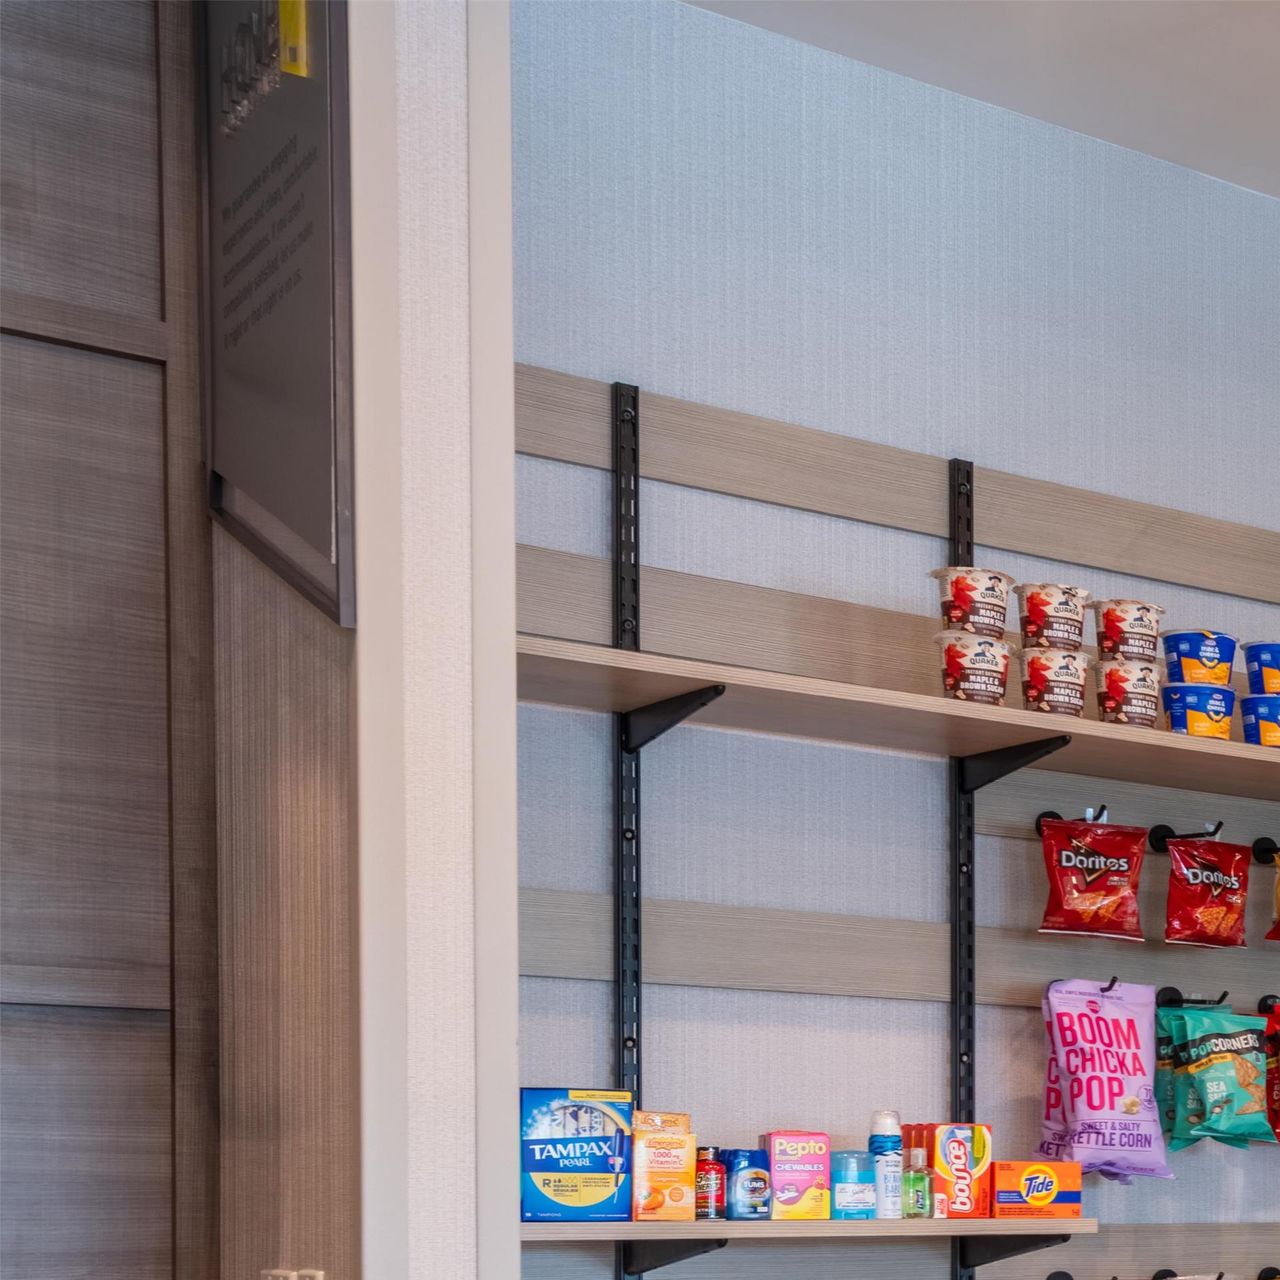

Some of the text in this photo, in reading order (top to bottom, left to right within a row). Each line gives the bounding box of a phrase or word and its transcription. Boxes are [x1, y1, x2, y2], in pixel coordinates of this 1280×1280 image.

[969, 656, 999, 667] QUAKER
[1060, 850, 1129, 872] Doritos
[1188, 868, 1240, 890] Doritos
[1056, 1011, 1141, 1050] BOOM
[1065, 1046, 1147, 1077] CHICKA
[1069, 1075, 1125, 1113] POP
[1206, 1081, 1227, 1093] SEA
[1081, 1121, 1141, 1132] SWEET & SALTY
[774, 1138, 827, 1156] Pepto
[1069, 1131, 1152, 1148] KETTLE CORN
[529, 1141, 613, 1160] TAMPAX
[1040, 1142, 1064, 1158] KET
[774, 1163, 824, 1171] CHEWABLES
[949, 1140, 974, 1212] bounce
[1023, 1175, 1054, 1199] Tide
